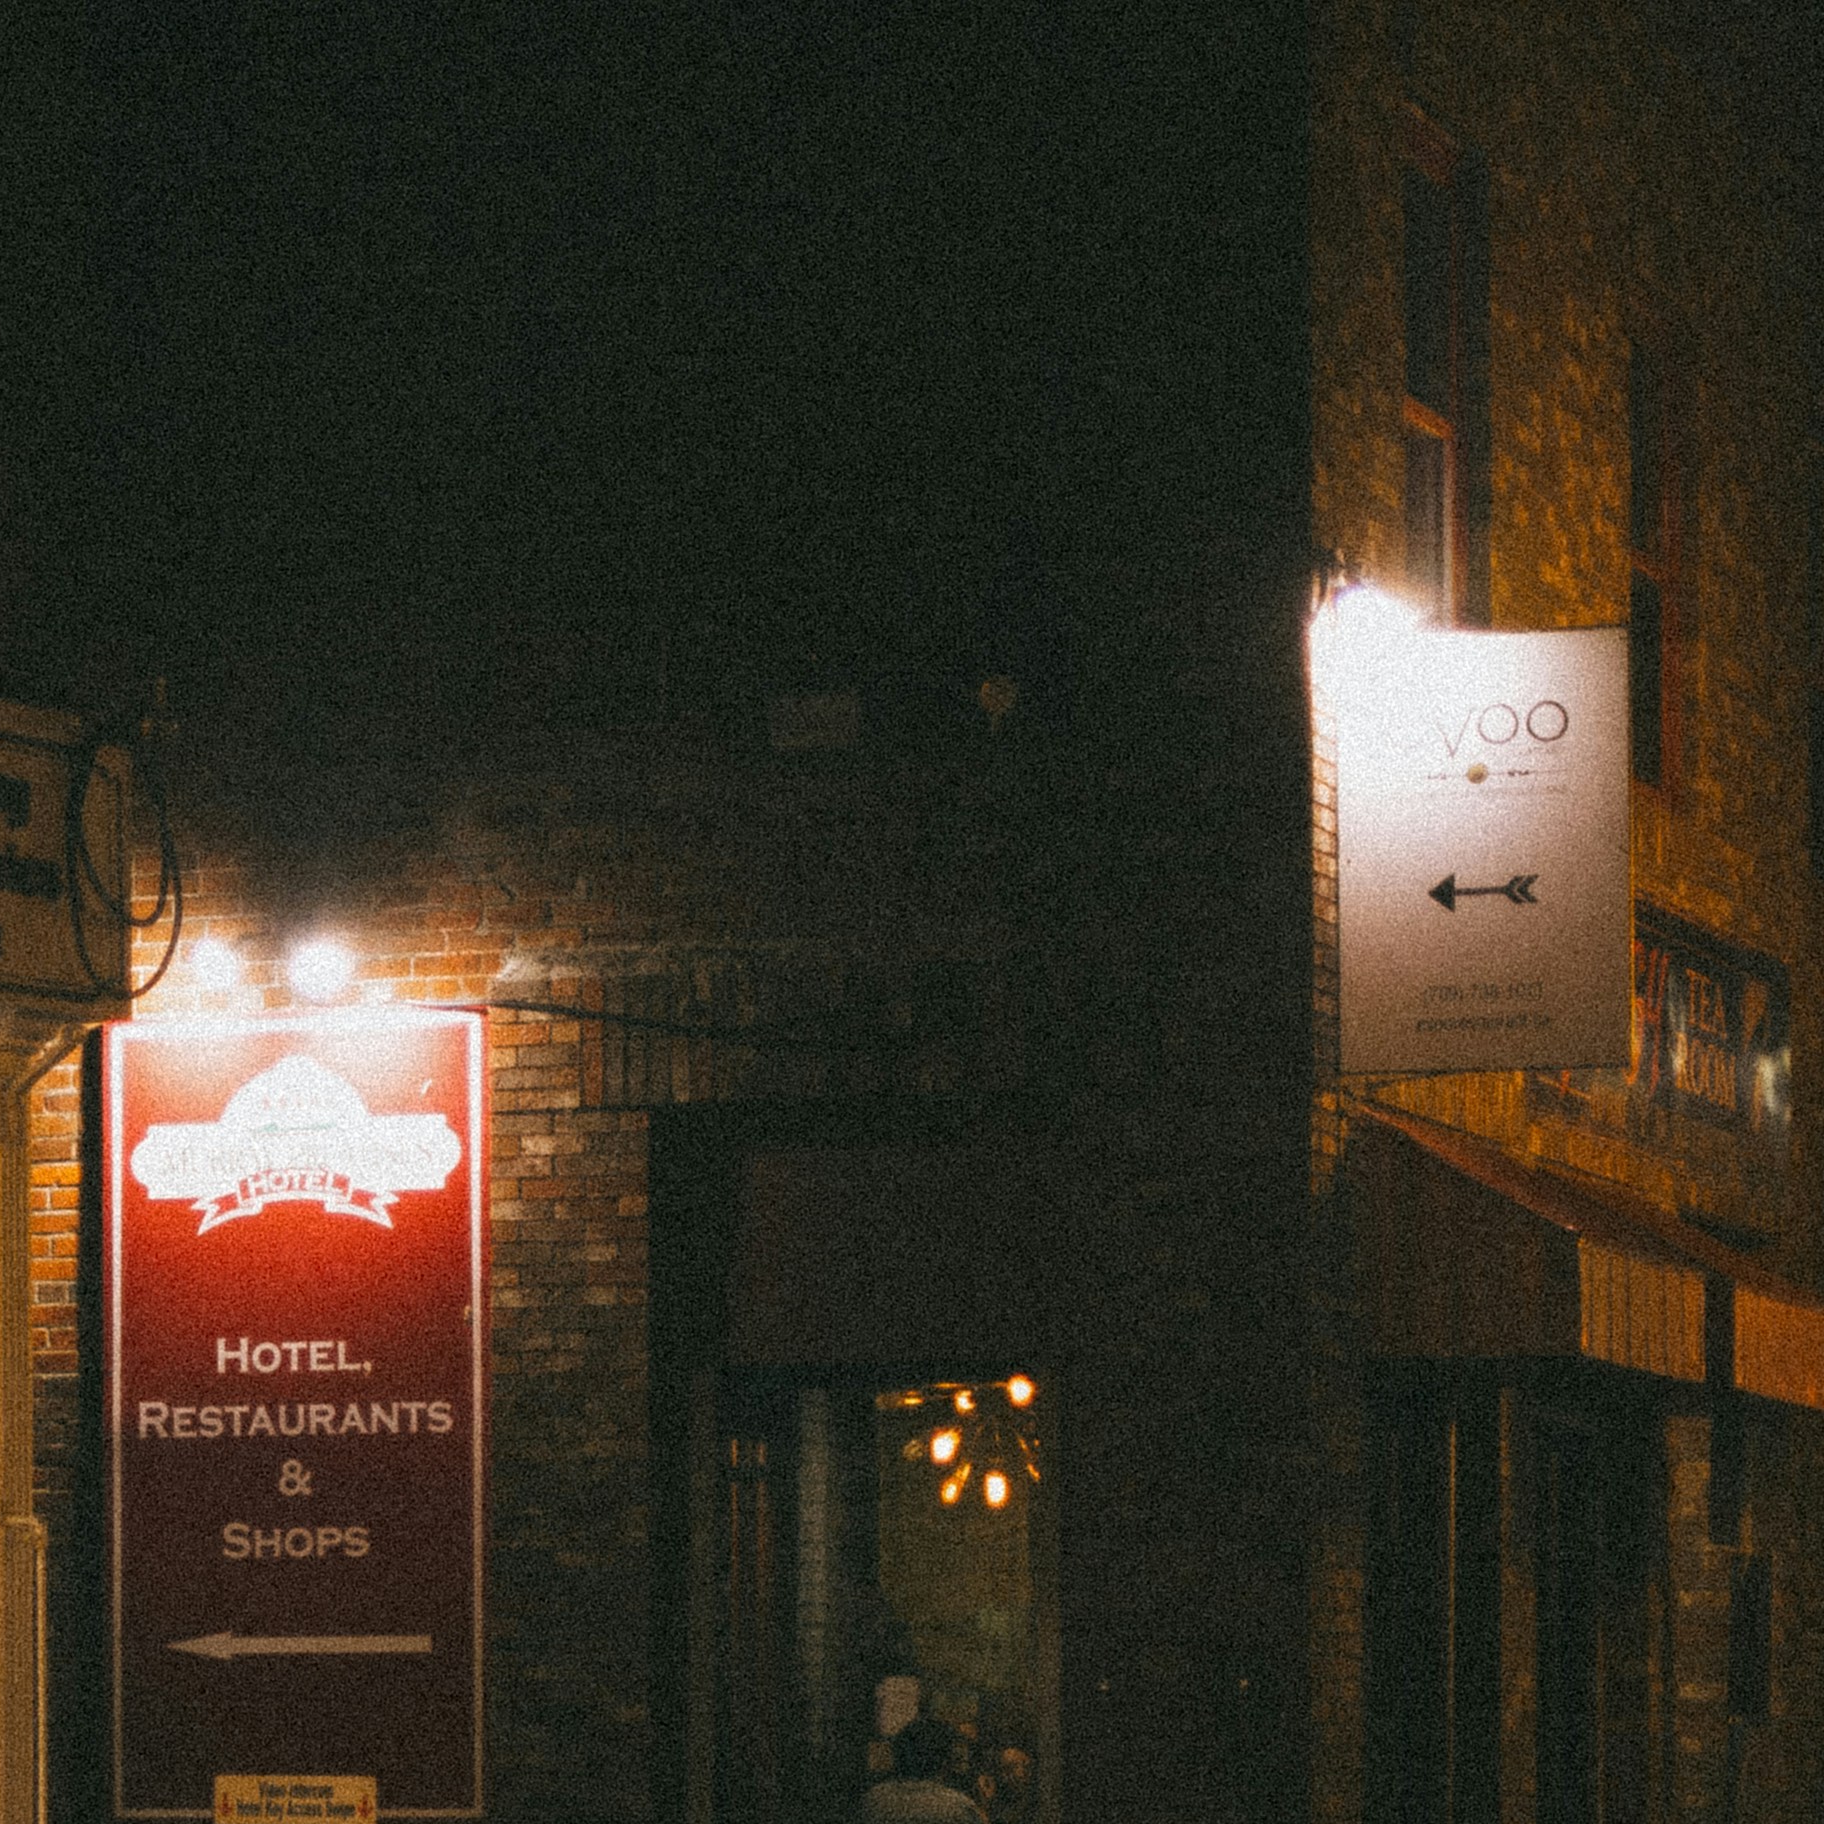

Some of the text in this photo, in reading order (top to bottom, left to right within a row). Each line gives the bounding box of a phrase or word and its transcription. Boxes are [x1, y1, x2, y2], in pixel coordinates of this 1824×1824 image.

[247, 1168, 350, 1199] HOTEL
[138, 1400, 454, 1439] RESTAURANTS
[278, 1459, 313, 1497] &
[222, 1522, 372, 1560] SHOPS
